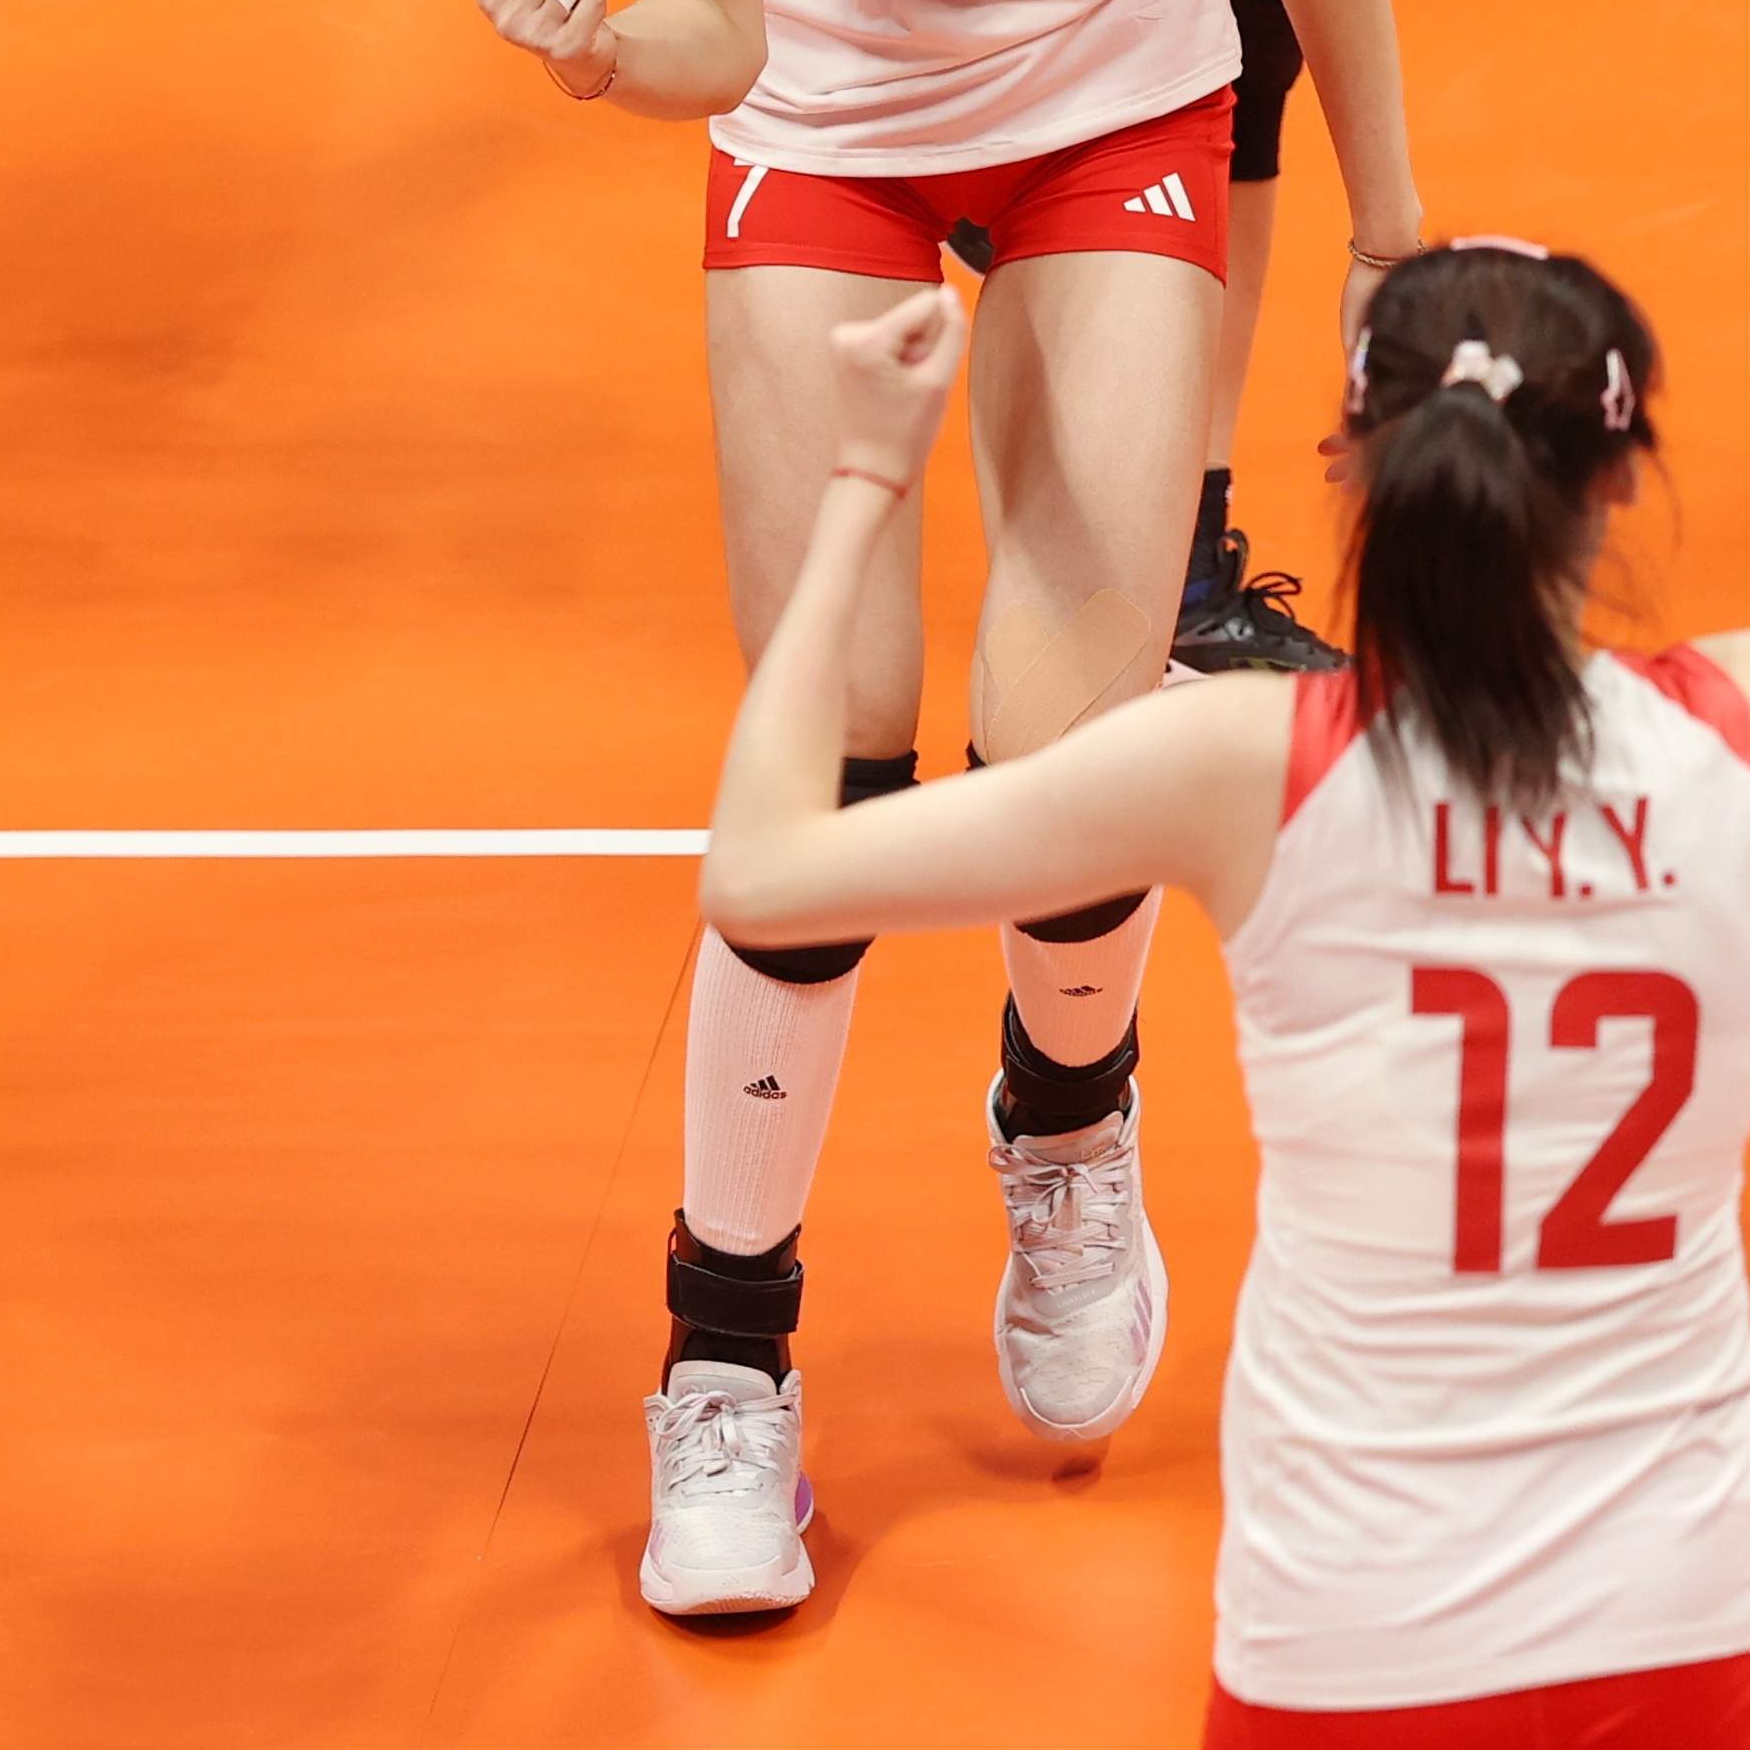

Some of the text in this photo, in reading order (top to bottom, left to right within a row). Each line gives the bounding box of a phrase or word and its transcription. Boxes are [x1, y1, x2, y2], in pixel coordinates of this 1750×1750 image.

[726, 157, 771, 239] 7
[743, 1085, 787, 1100] adidas
[1410, 964, 1701, 1276] 12
